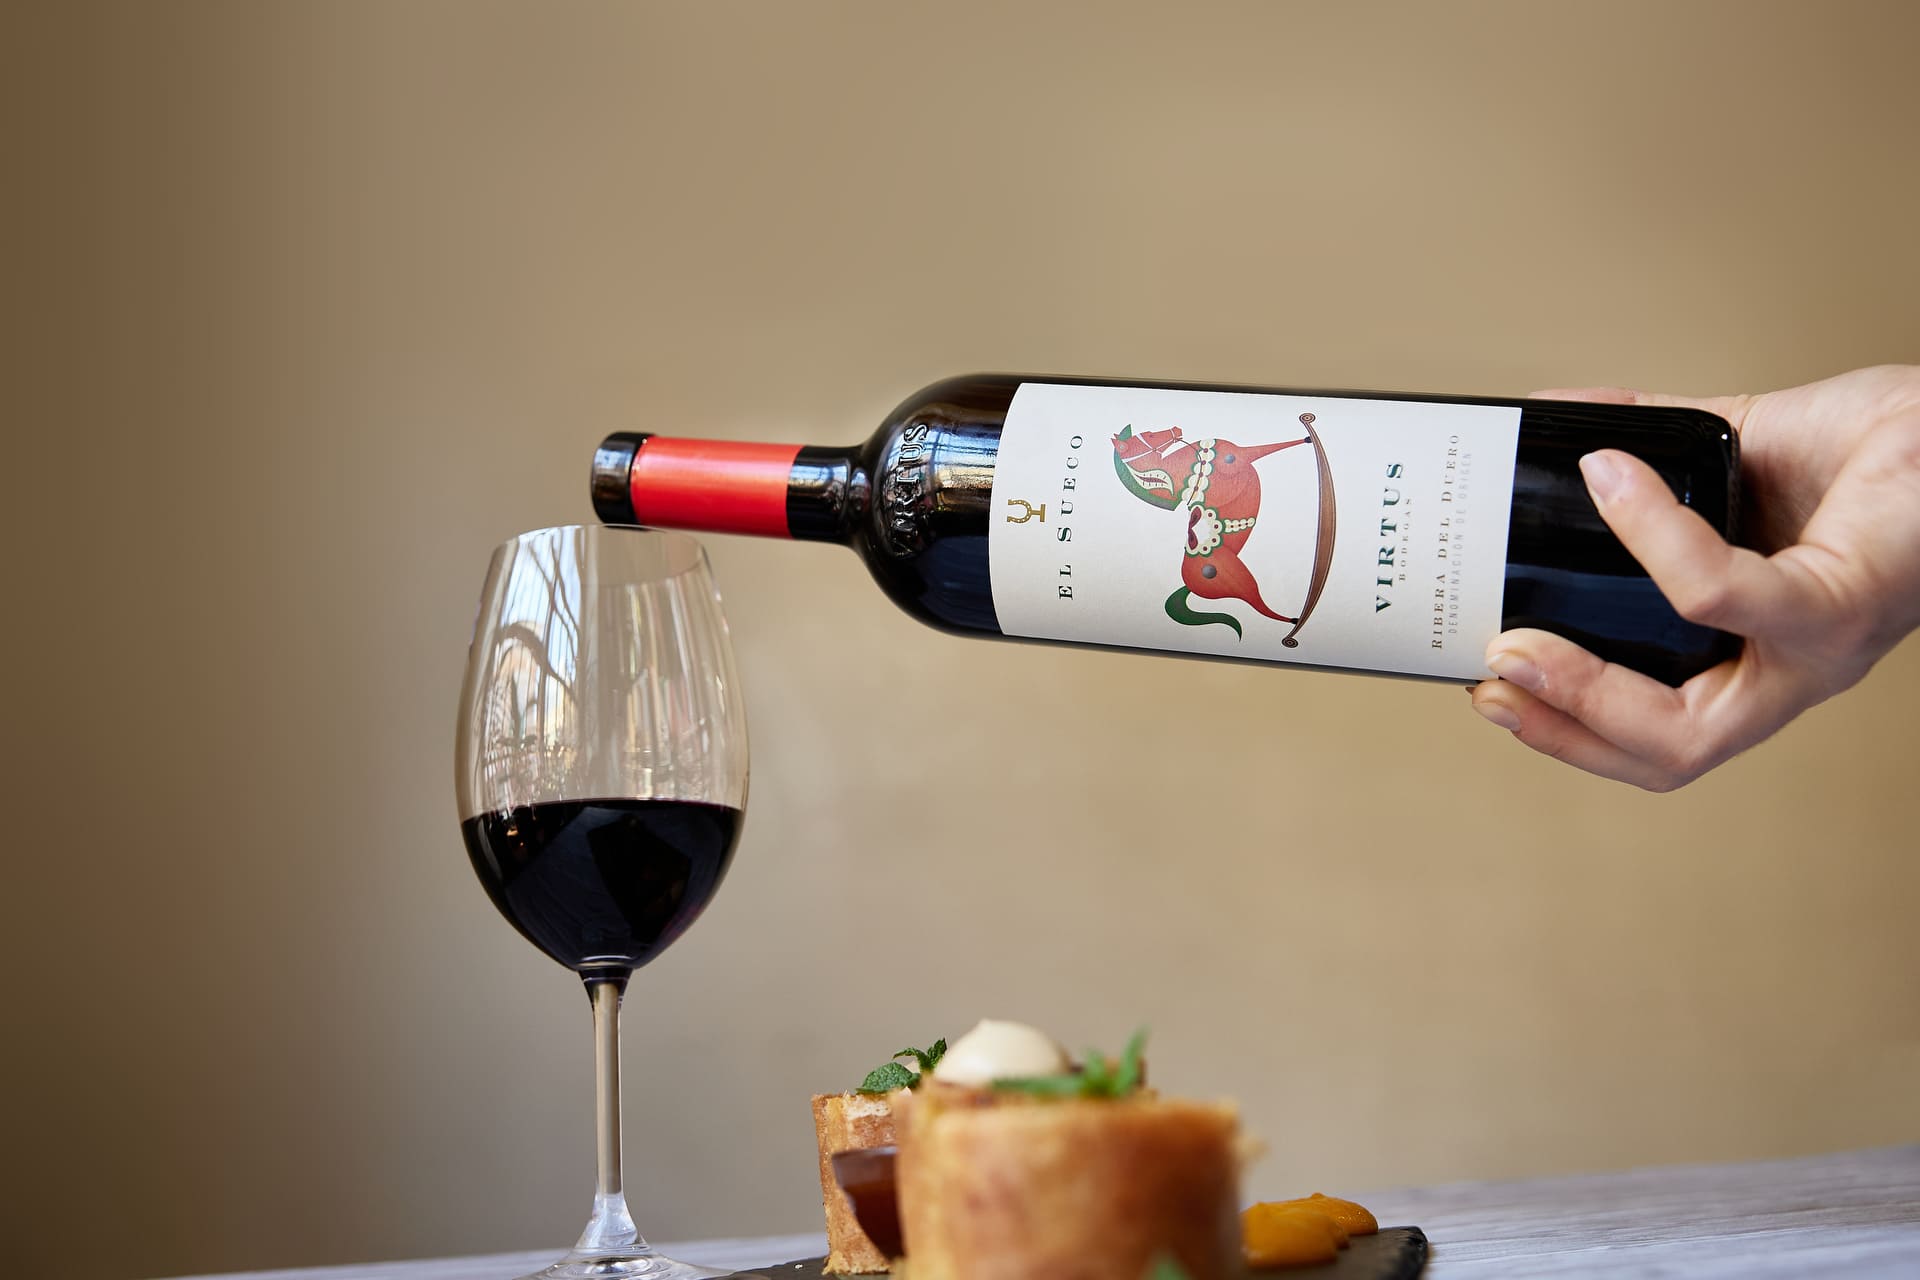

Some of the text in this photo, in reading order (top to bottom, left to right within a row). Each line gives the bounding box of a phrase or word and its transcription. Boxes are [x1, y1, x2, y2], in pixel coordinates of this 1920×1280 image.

[1057, 435, 1083, 601] EL SUECO
[1456, 508, 1467, 524] DE
[1459, 452, 1472, 500] ORIGEN
[1375, 463, 1403, 613] VIRTUS
[1399, 498, 1411, 581] BODEGAS
[1432, 435, 1458, 649] RIBERA DEL DUERO
